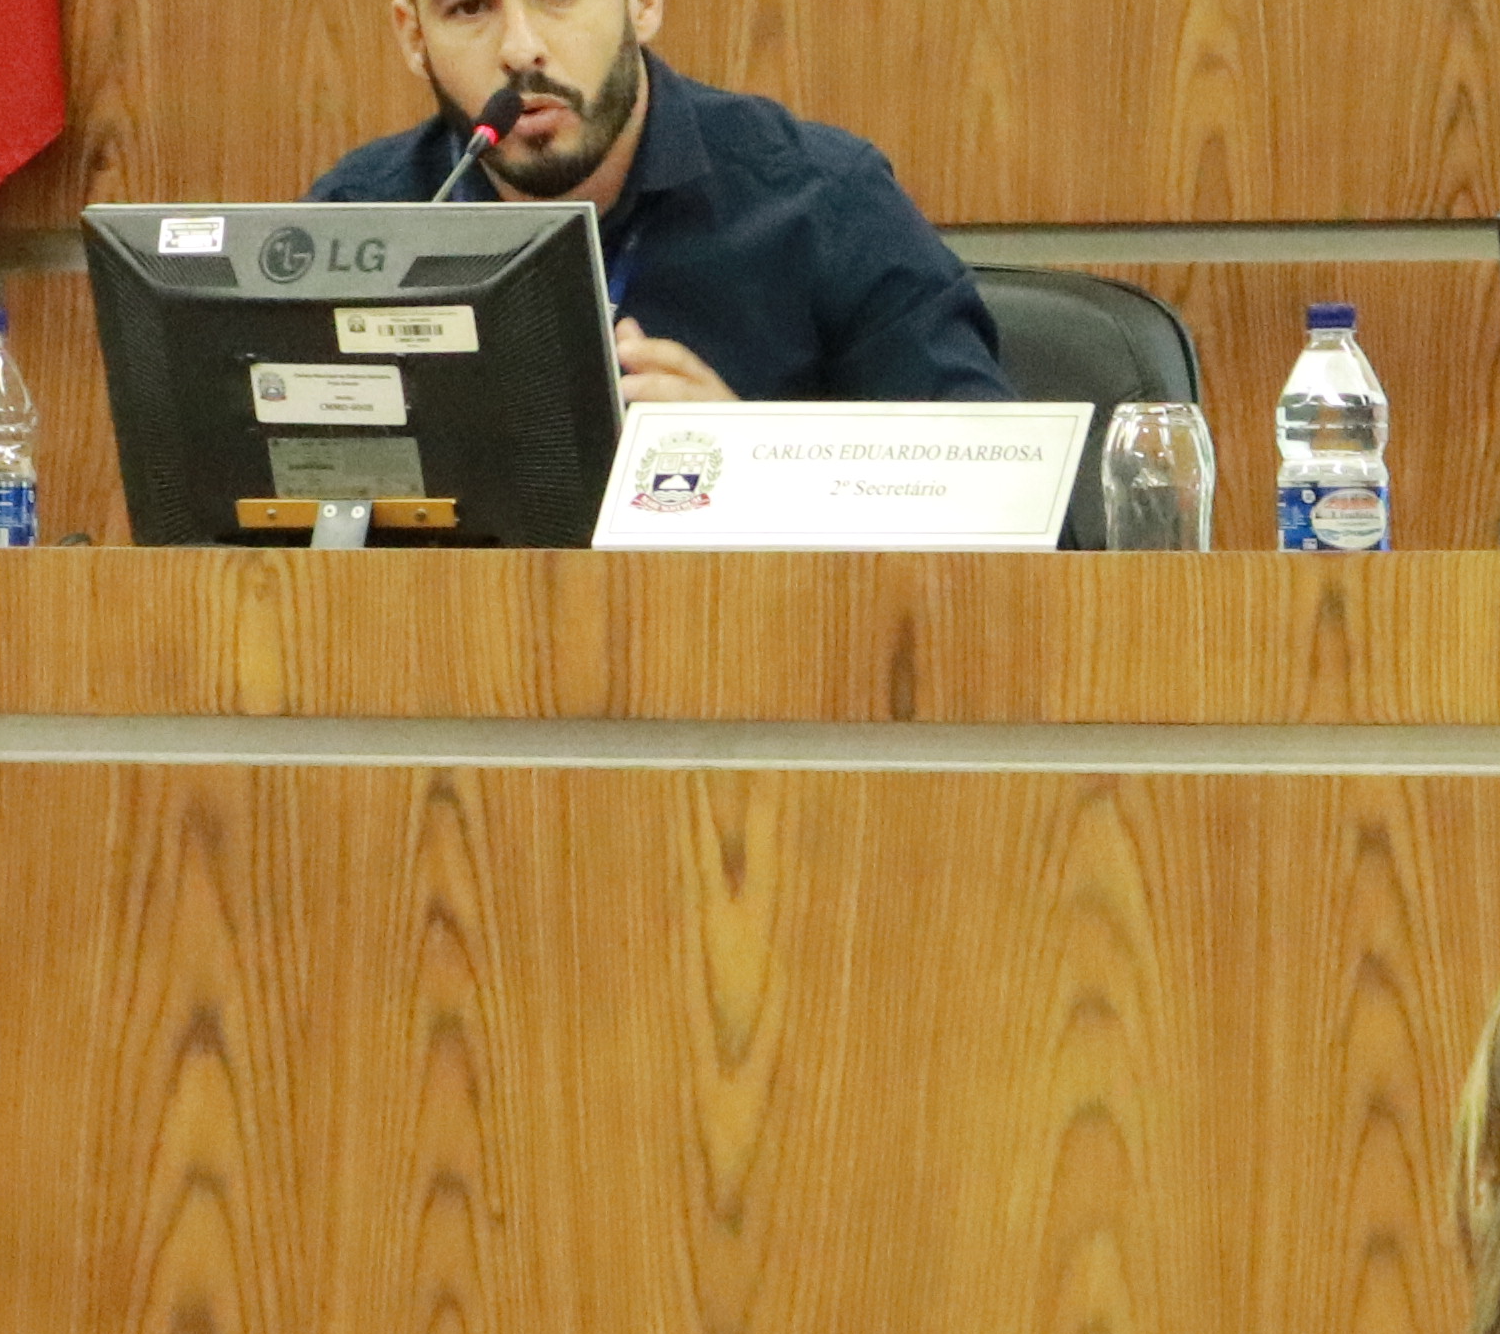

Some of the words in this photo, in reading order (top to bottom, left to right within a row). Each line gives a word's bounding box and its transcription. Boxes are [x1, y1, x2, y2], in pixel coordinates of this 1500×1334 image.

[326, 238, 388, 272] LG
[751, 444, 834, 461] CARLOS
[839, 444, 942, 461] EDUARDO
[945, 444, 1045, 462] BARBOSA
[853, 478, 948, 497] Secretário
